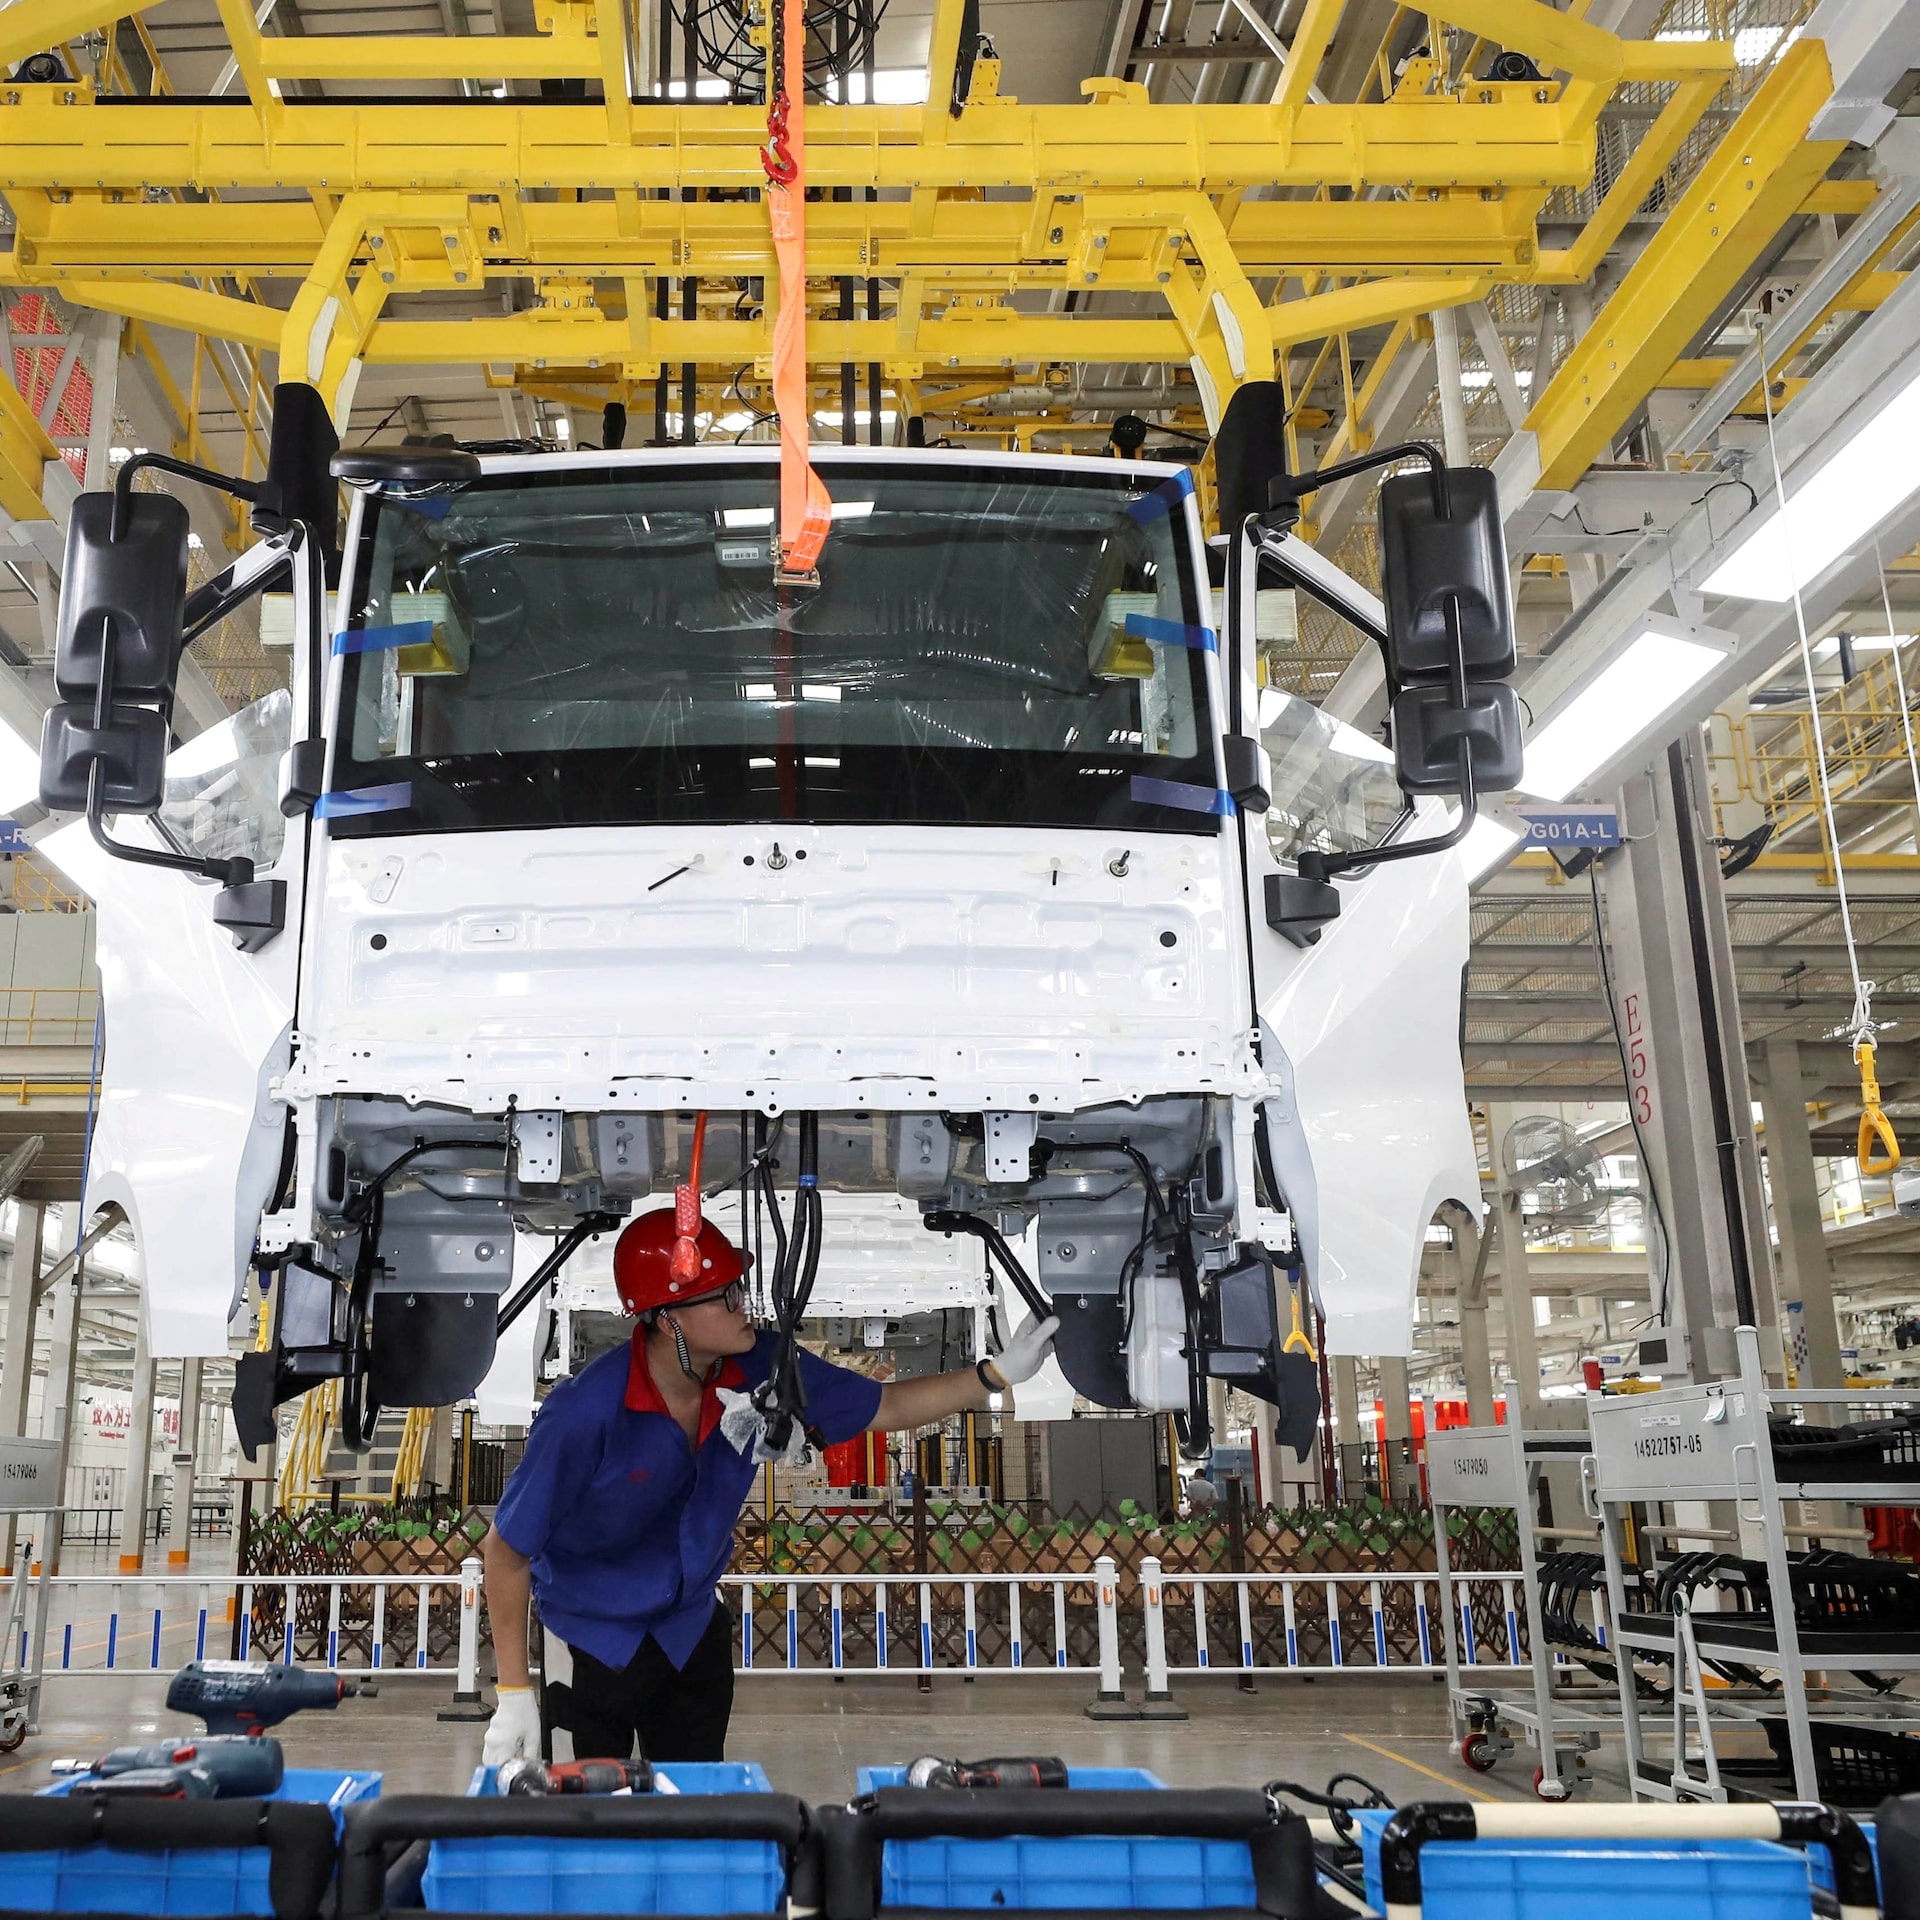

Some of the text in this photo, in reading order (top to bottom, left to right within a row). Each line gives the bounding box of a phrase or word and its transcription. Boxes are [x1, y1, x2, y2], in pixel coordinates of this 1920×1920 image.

[1531, 822, 1612, 839] G01A-L
[1624, 994, 1652, 1125] E53
[1634, 1434, 1702, 1459] 14522757-05
